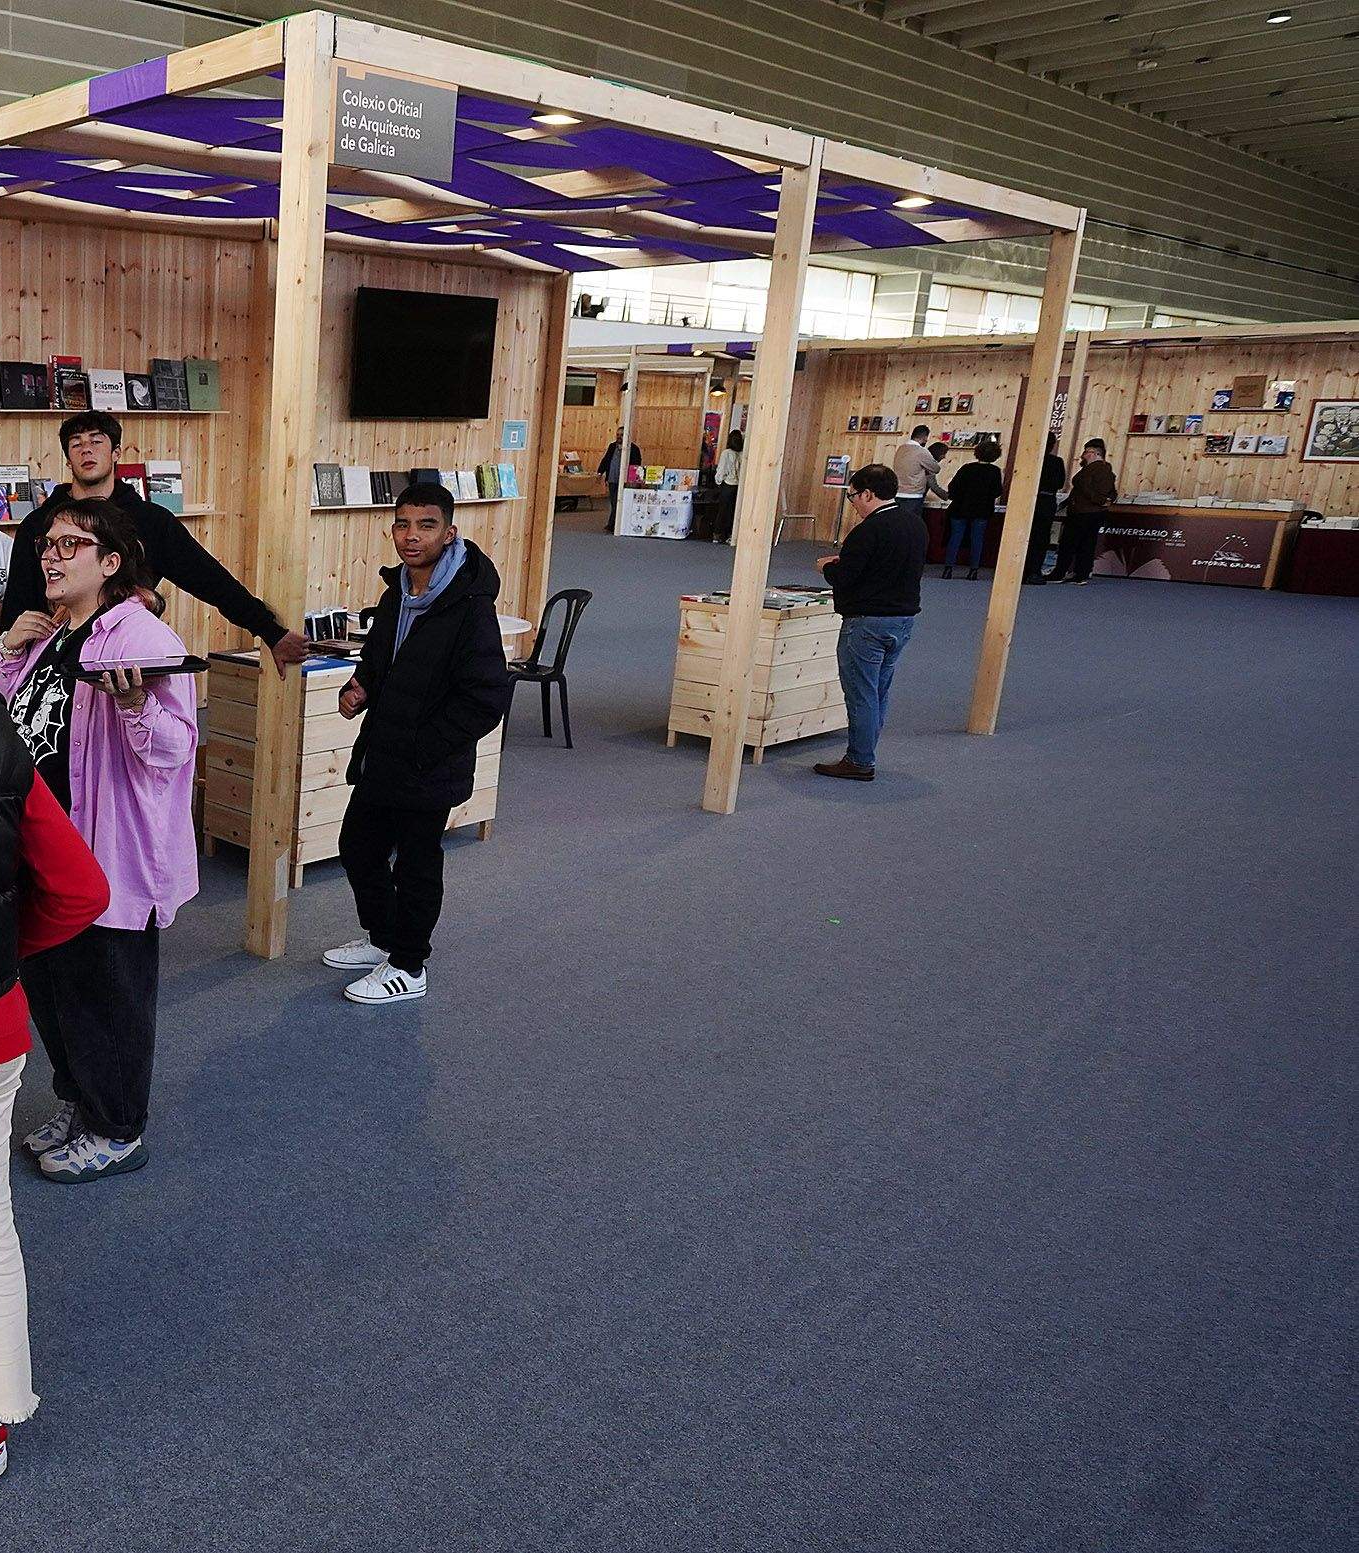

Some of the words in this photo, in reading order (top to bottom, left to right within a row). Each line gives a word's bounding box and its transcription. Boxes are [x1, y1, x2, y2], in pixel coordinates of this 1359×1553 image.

[342, 89, 385, 112] Colexio
[387, 97, 423, 119] Oficial
[341, 111, 357, 128] de
[358, 115, 421, 140] Arquitectos
[340, 133, 356, 151] de
[358, 136, 396, 157] Galicia
[1105, 527, 1169, 538] ANIVERSARIO
